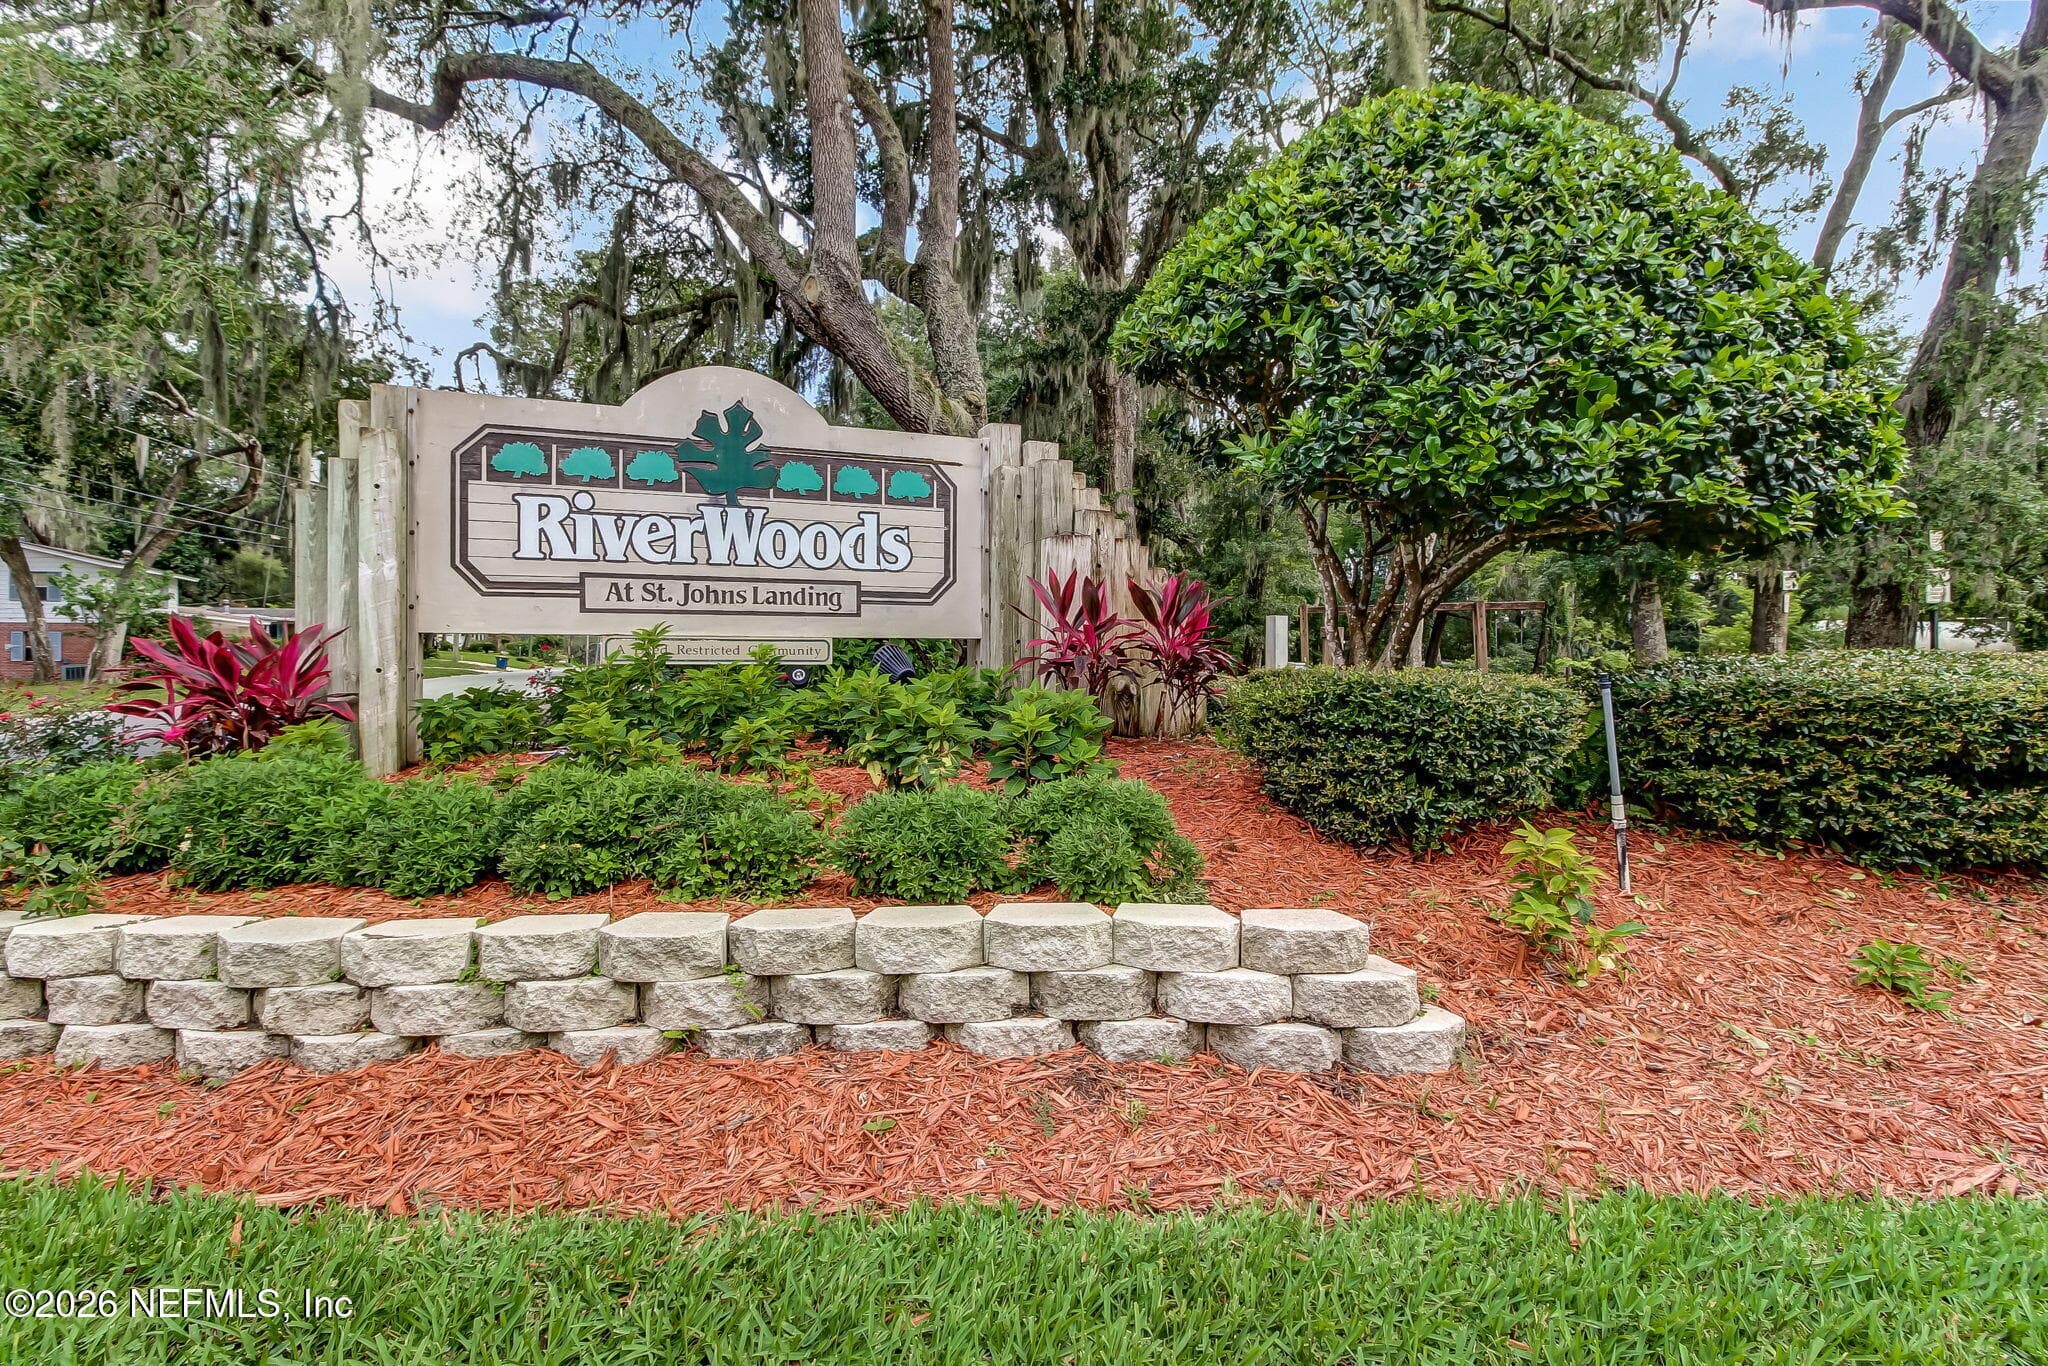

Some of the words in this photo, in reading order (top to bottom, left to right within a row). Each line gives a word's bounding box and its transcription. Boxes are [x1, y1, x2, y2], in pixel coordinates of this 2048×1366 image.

[513, 491, 913, 571] RiverWoods
[605, 582, 634, 602] At
[641, 582, 673, 602] St.
[677, 583, 747, 606] Johns
[752, 586, 842, 612] Landing
[616, 644, 625, 655] A
[677, 644, 740, 656] Restricted
[748, 645, 822, 659] Cmunity
